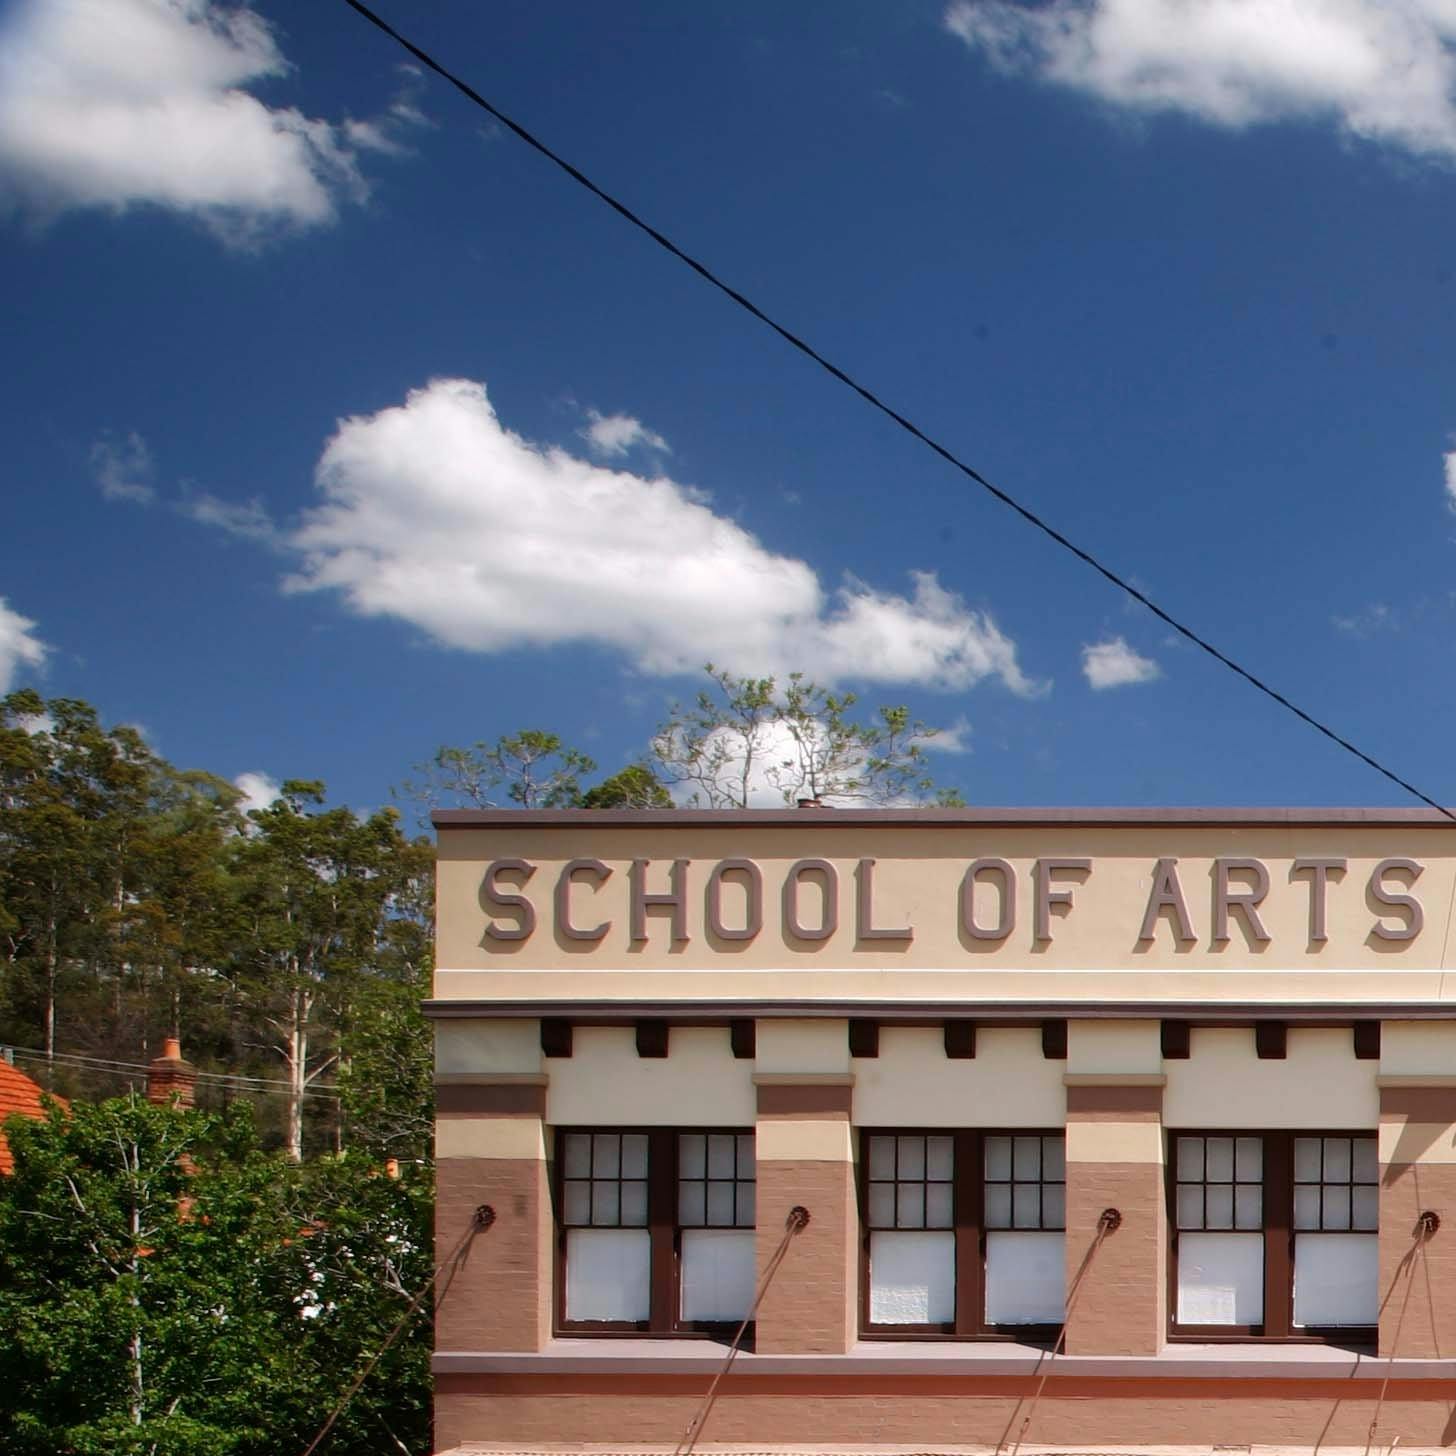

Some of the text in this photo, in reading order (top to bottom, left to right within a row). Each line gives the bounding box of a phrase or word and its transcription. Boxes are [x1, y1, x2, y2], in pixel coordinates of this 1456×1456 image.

[479, 857, 1425, 952] SCHOOL OF ARTS
